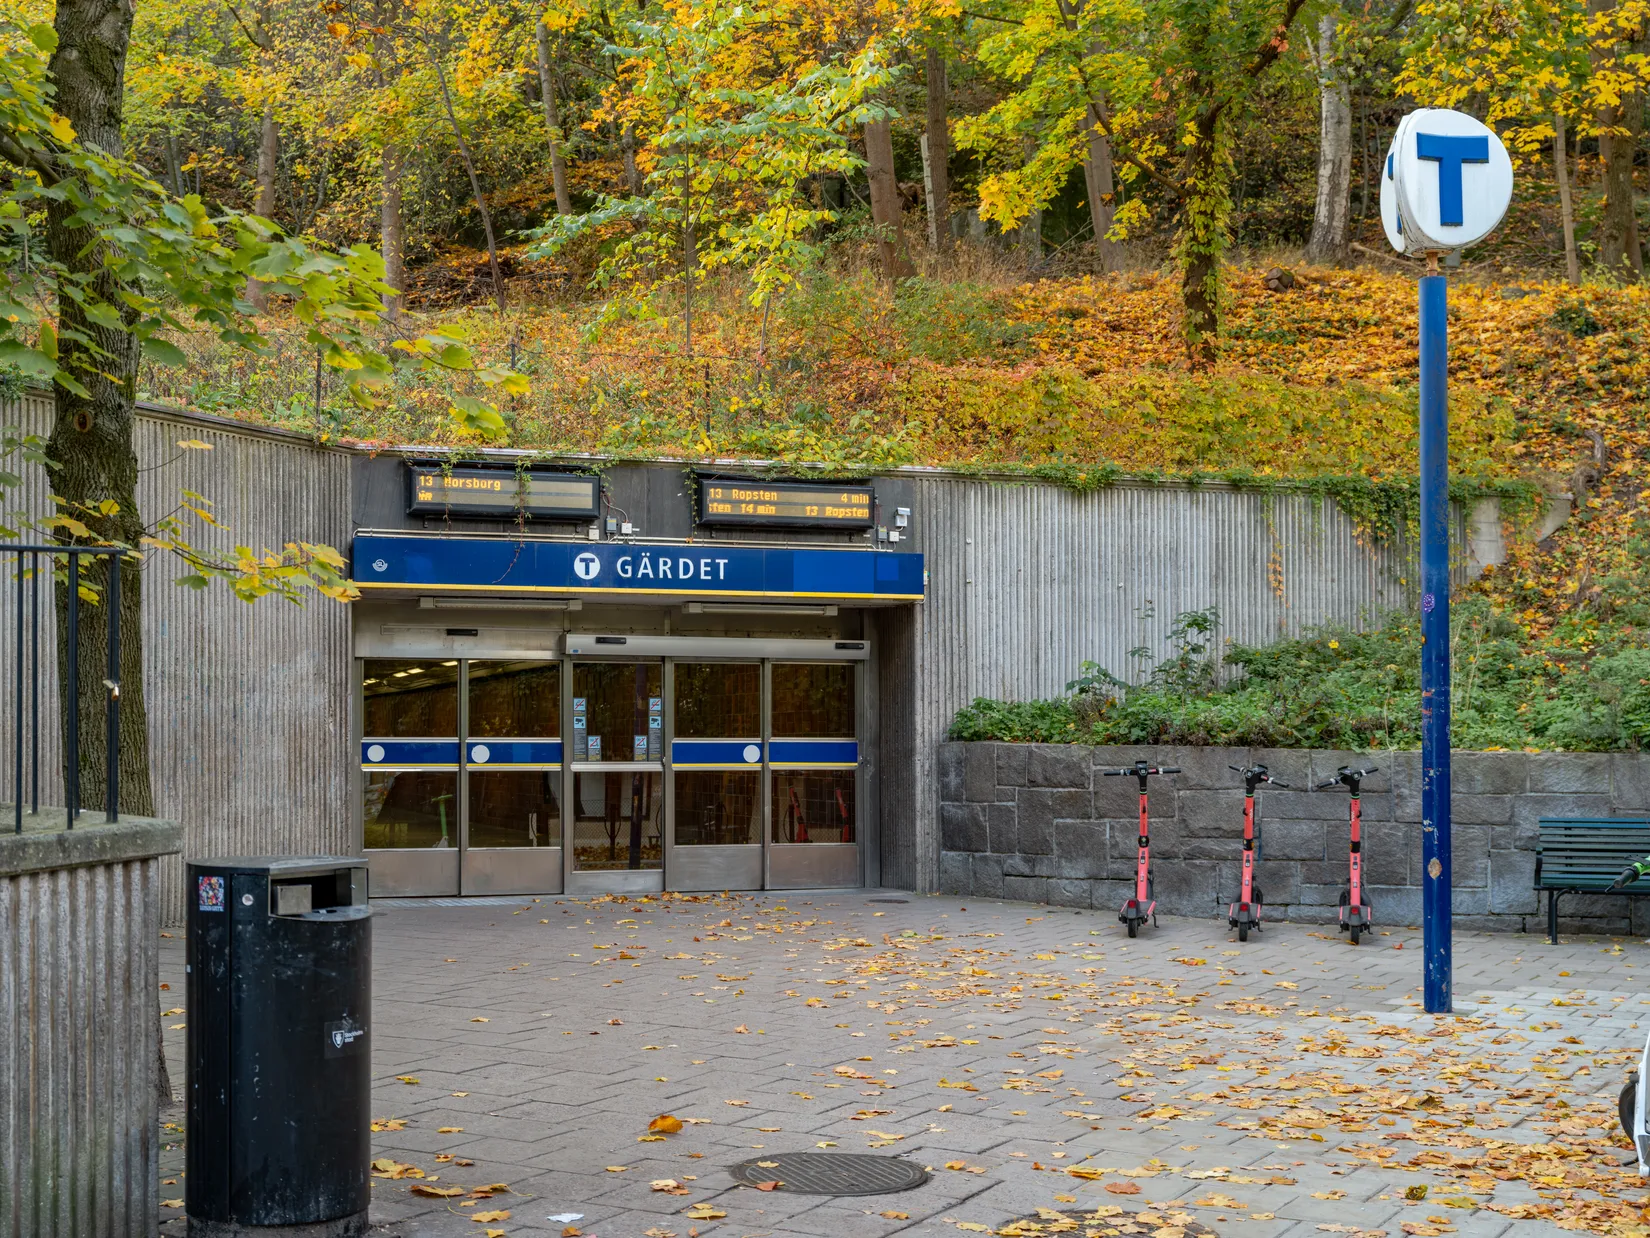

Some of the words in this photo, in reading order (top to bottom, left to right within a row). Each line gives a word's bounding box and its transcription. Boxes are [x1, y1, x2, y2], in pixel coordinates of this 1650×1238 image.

[1416, 132, 1489, 227] T
[419, 475, 433, 486] 13
[444, 476, 501, 491] Norsborg
[710, 488, 722, 499] 13
[732, 489, 778, 501] Ropsten
[841, 493, 848, 503] 4
[851, 493, 869, 504] min
[740, 503, 754, 514] 14
[756, 504, 776, 515] min
[805, 506, 818, 516] 13
[825, 507, 869, 519] Ropsten
[579, 557, 596, 576] T
[616, 552, 729, 580] GÄRDET
